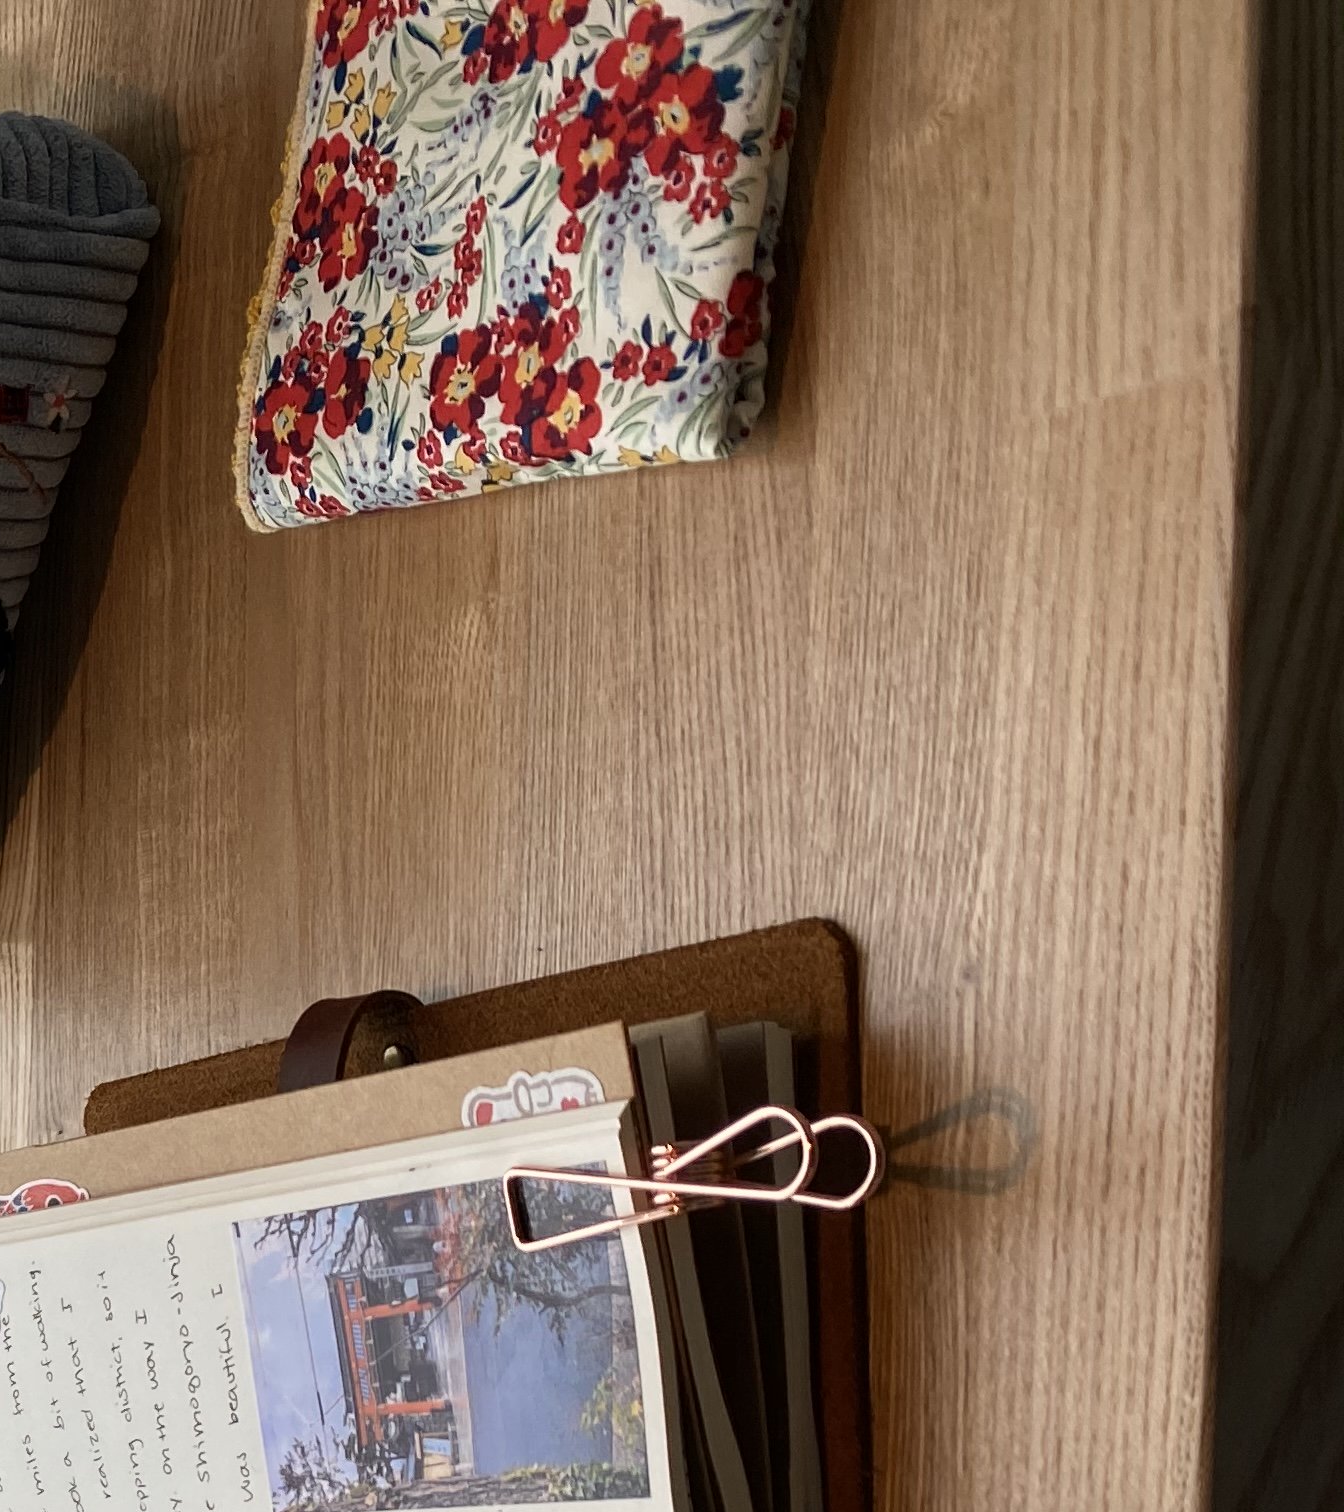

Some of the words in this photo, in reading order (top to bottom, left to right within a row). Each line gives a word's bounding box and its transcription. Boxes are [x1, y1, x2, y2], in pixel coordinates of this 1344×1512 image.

[0, 1314, 16, 1352] the
[6, 1361, 24, 1415] from
[41, 1359, 54, 1382] of
[68, 1337, 87, 1395] that
[143, 1342, 158, 1391] way
[153, 1403, 166, 1442] the
[22, 1435, 44, 1496] miles
[64, 1451, 73, 1467] a
[81, 1410, 112, 1499] realized
